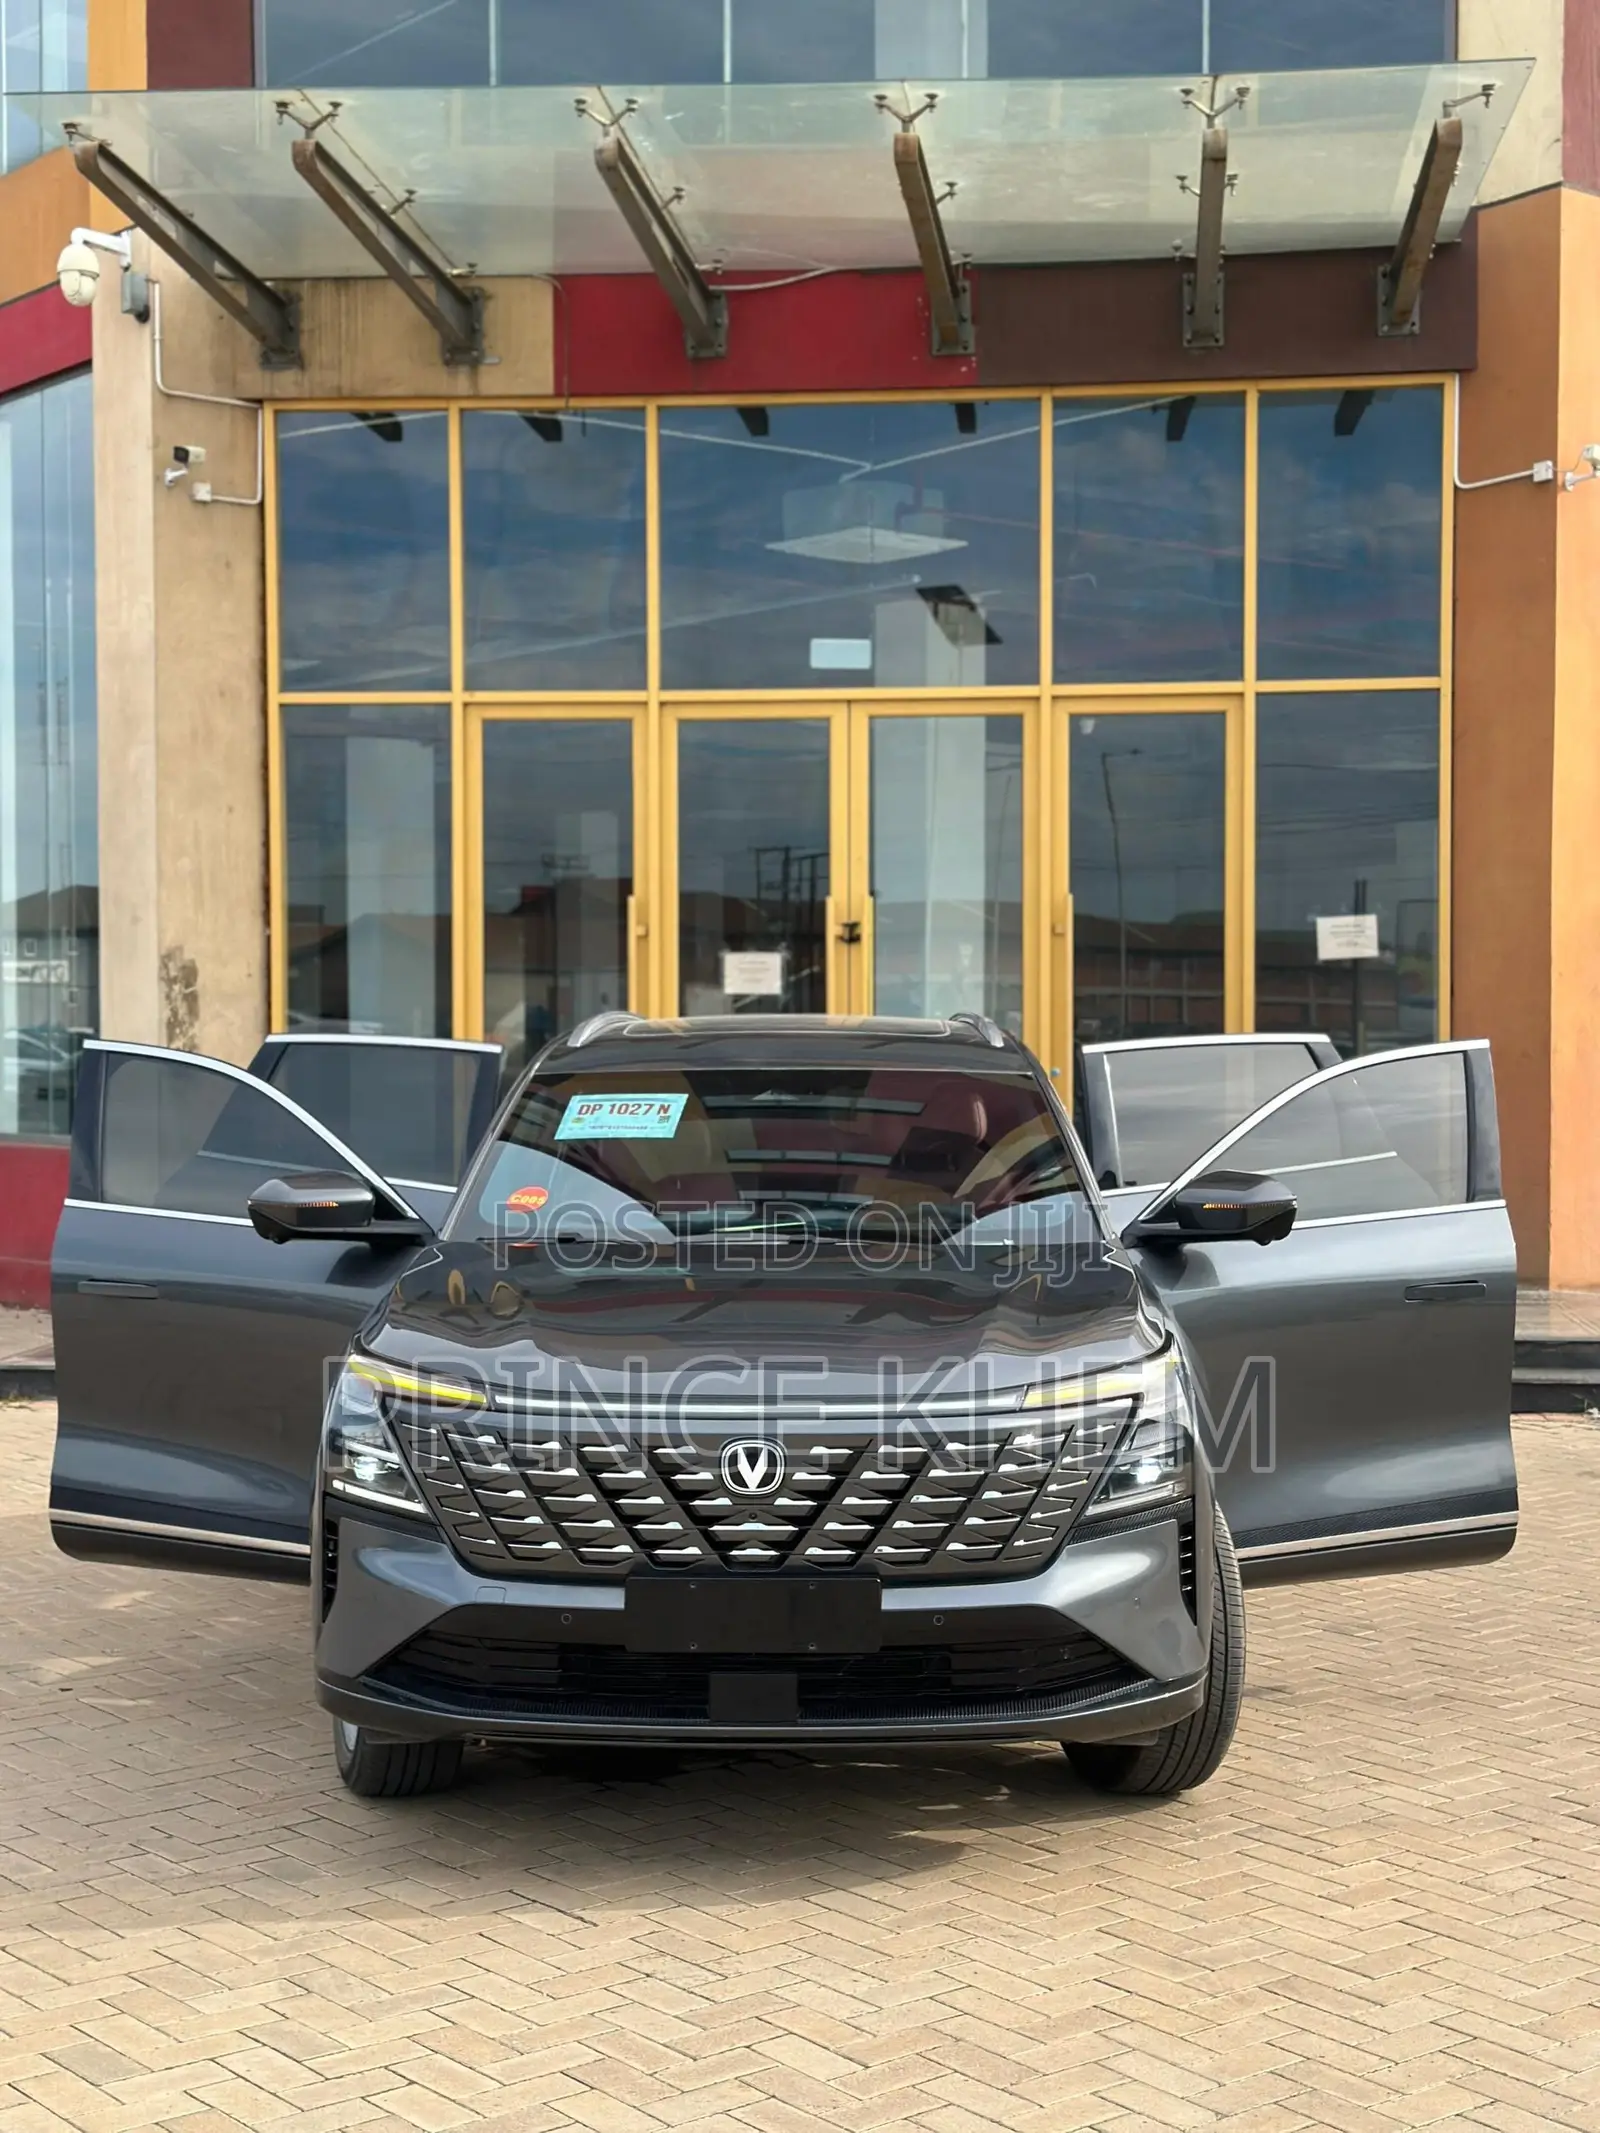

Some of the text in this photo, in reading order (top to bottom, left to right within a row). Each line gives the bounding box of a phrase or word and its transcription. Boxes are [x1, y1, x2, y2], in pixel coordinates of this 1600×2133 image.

[577, 1103, 671, 1116] DP 1027 N
